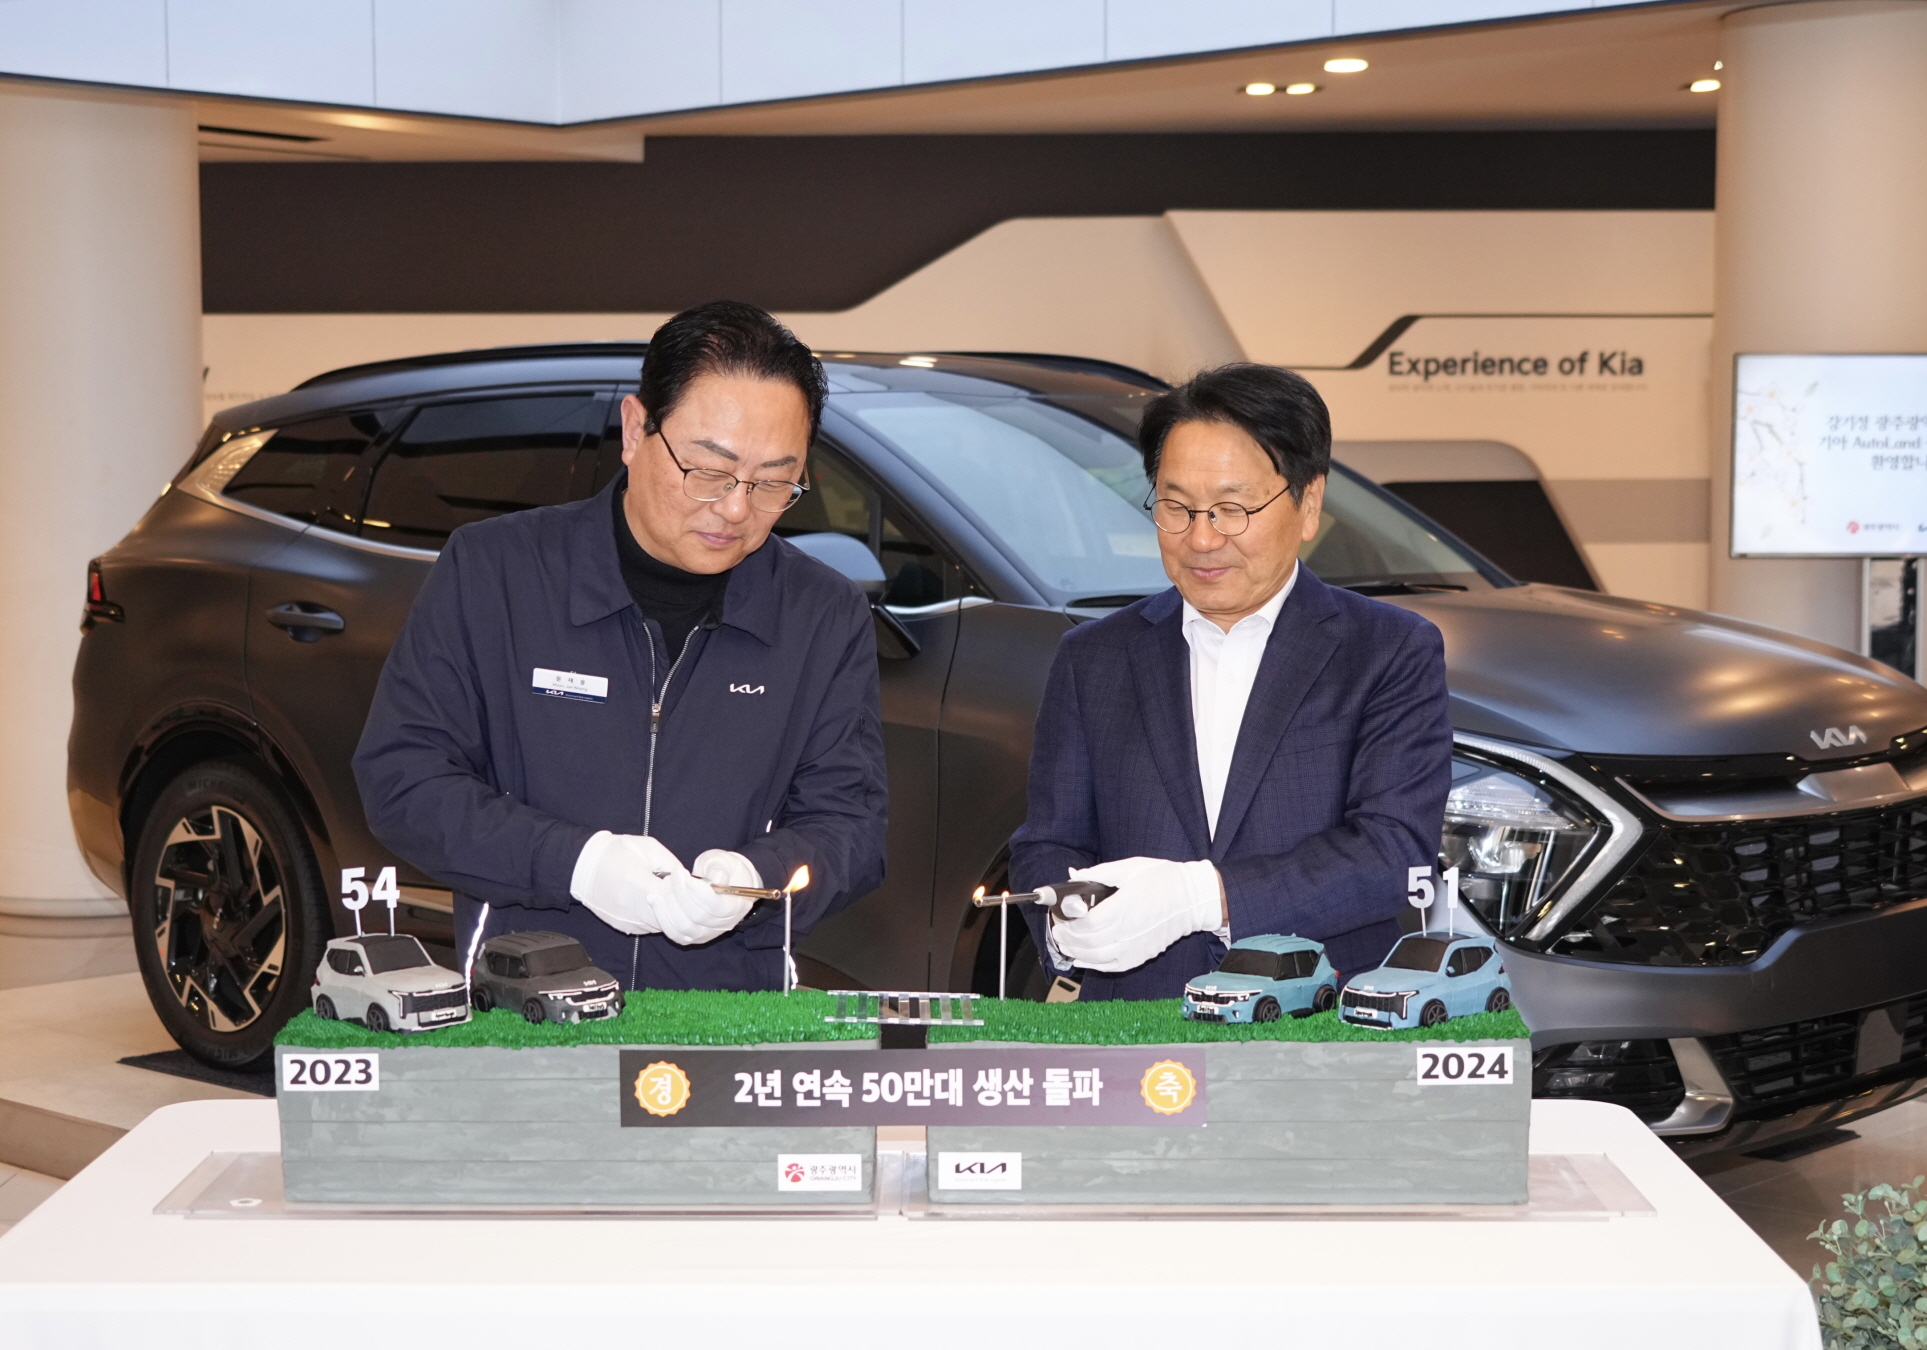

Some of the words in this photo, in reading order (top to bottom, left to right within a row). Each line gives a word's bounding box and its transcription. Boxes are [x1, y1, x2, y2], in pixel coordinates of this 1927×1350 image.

[1388, 351, 1548, 381] Experience
[1558, 350, 1590, 375] of
[1599, 351, 1645, 376] Kia
[729, 683, 765, 694] KIA
[1810, 725, 1867, 750] KIA
[340, 866, 400, 910] 54
[1407, 865, 1460, 909] 51
[289, 1058, 373, 1085] 2023
[1421, 1052, 1508, 1080] 2024
[648, 1073, 672, 1105] 경
[733, 1069, 782, 1107] 2년
[792, 1069, 853, 1108] 연속
[861, 1068, 963, 1107] 50만대
[972, 1067, 1034, 1106] 생산
[1042, 1067, 1103, 1106] 돌파
[1154, 1071, 1183, 1103] 축
[809, 1165, 857, 1175] 광주광역시
[954, 1162, 1007, 1174] KIA
